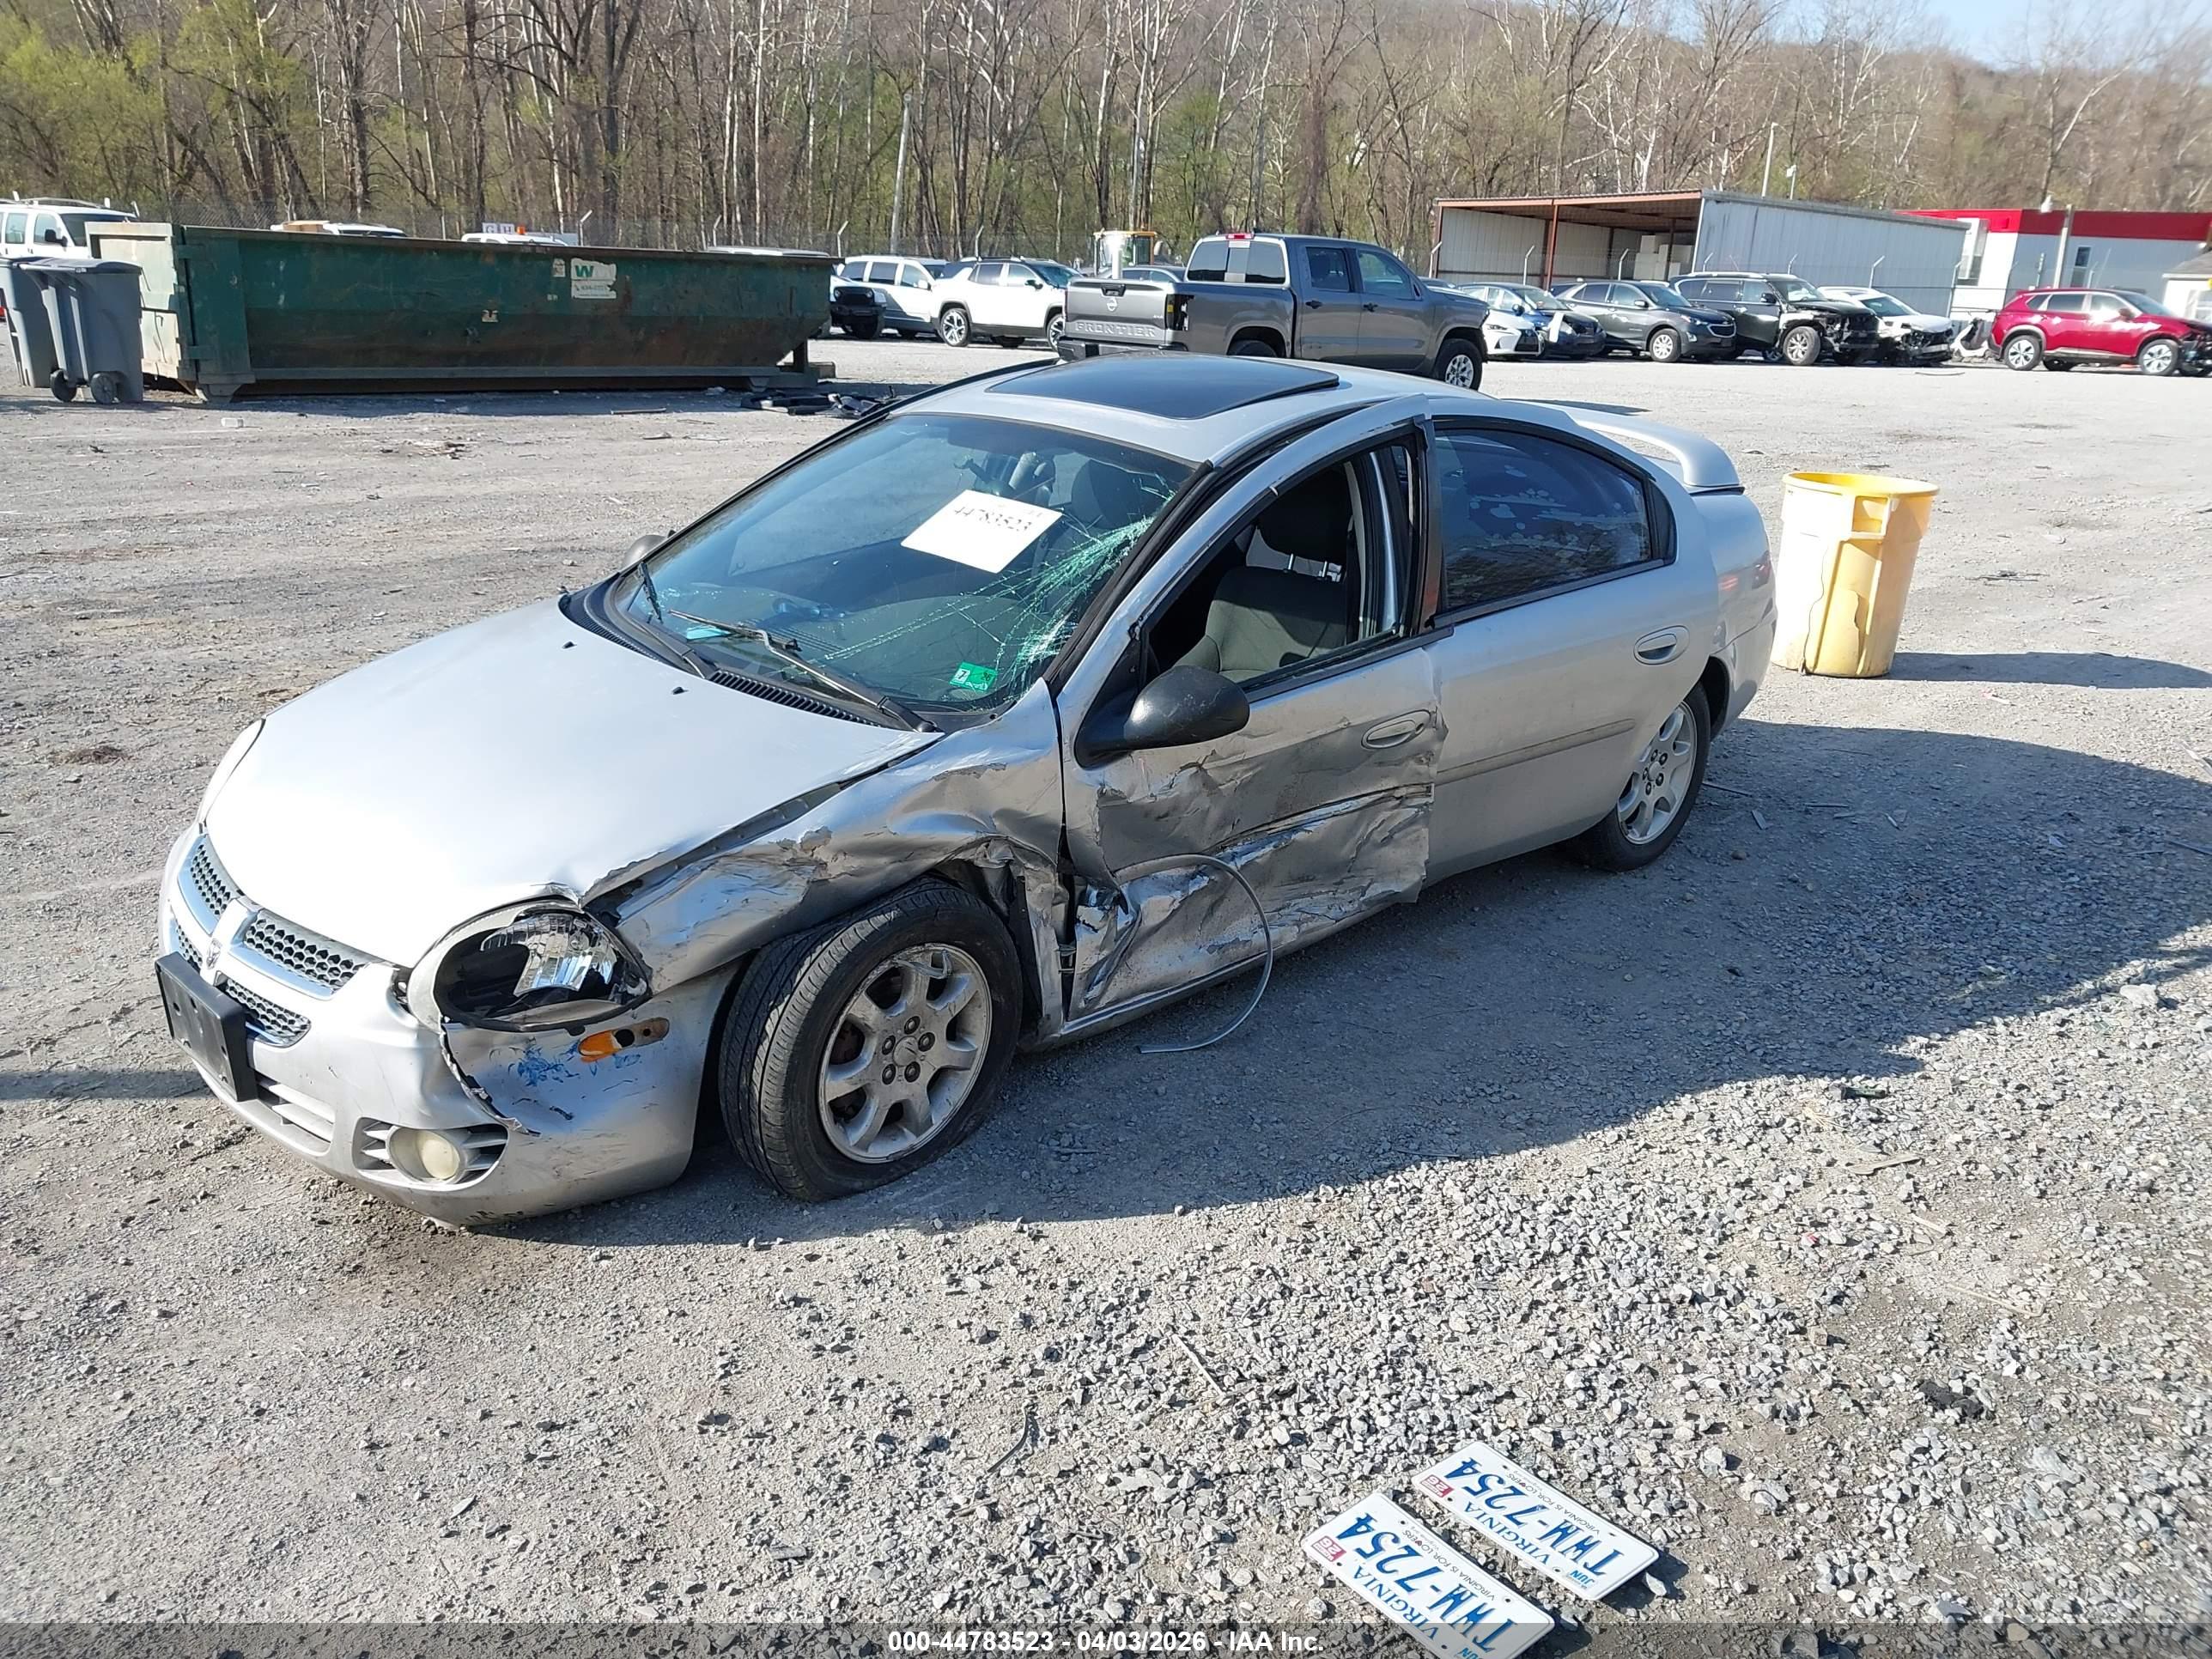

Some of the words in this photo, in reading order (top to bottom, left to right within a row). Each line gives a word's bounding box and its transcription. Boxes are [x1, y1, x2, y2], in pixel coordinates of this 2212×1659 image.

[1075, 321, 1156, 337] FRONTIER
[958, 670, 968, 680] 7
[1429, 1475, 1449, 1492] 26
[1538, 1494, 1556, 1505] FOR
[1443, 1457, 1624, 1576] TWM-7254
[1565, 1510, 1600, 1535] VIRGINIA
[1465, 1501, 1550, 1564] VIRGINIA
[1321, 1537, 1341, 1555] 26
[1433, 1553, 1451, 1568] FOR
[1336, 1513, 1517, 1653] TWM-7254
[1460, 1571, 1495, 1601] VIRGINIA
[1570, 1570, 1595, 1585] JUN
[1353, 1565, 1439, 1640] VIRGINIA
